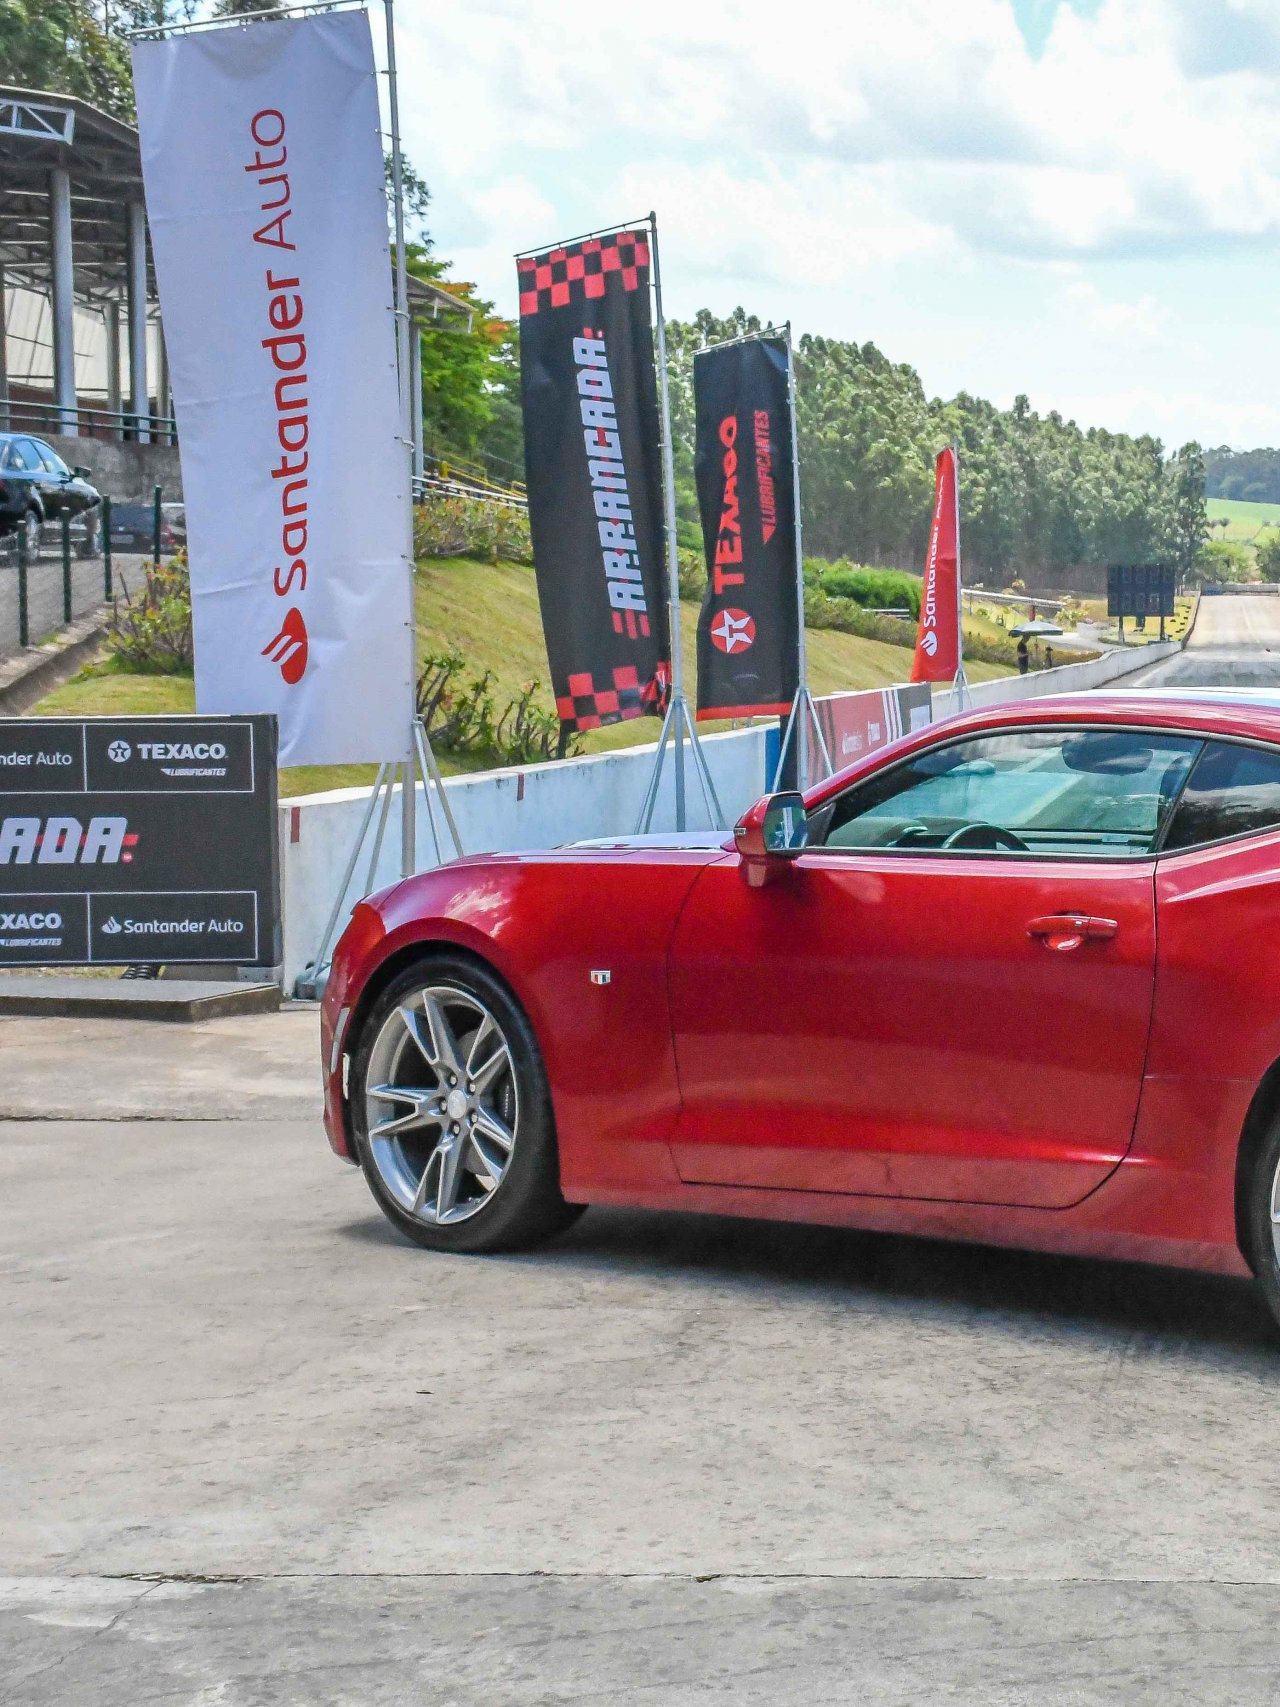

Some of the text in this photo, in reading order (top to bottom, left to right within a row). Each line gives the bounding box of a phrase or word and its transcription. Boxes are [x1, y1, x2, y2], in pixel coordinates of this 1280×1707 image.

[244, 108, 307, 598] Santander Auto
[713, 415, 746, 595] TEXACO
[923, 525, 939, 628] Santander
[36, 751, 73, 766] Auto
[137, 743, 226, 760] TEXACO
[123, 918, 244, 935] Santander Auto
